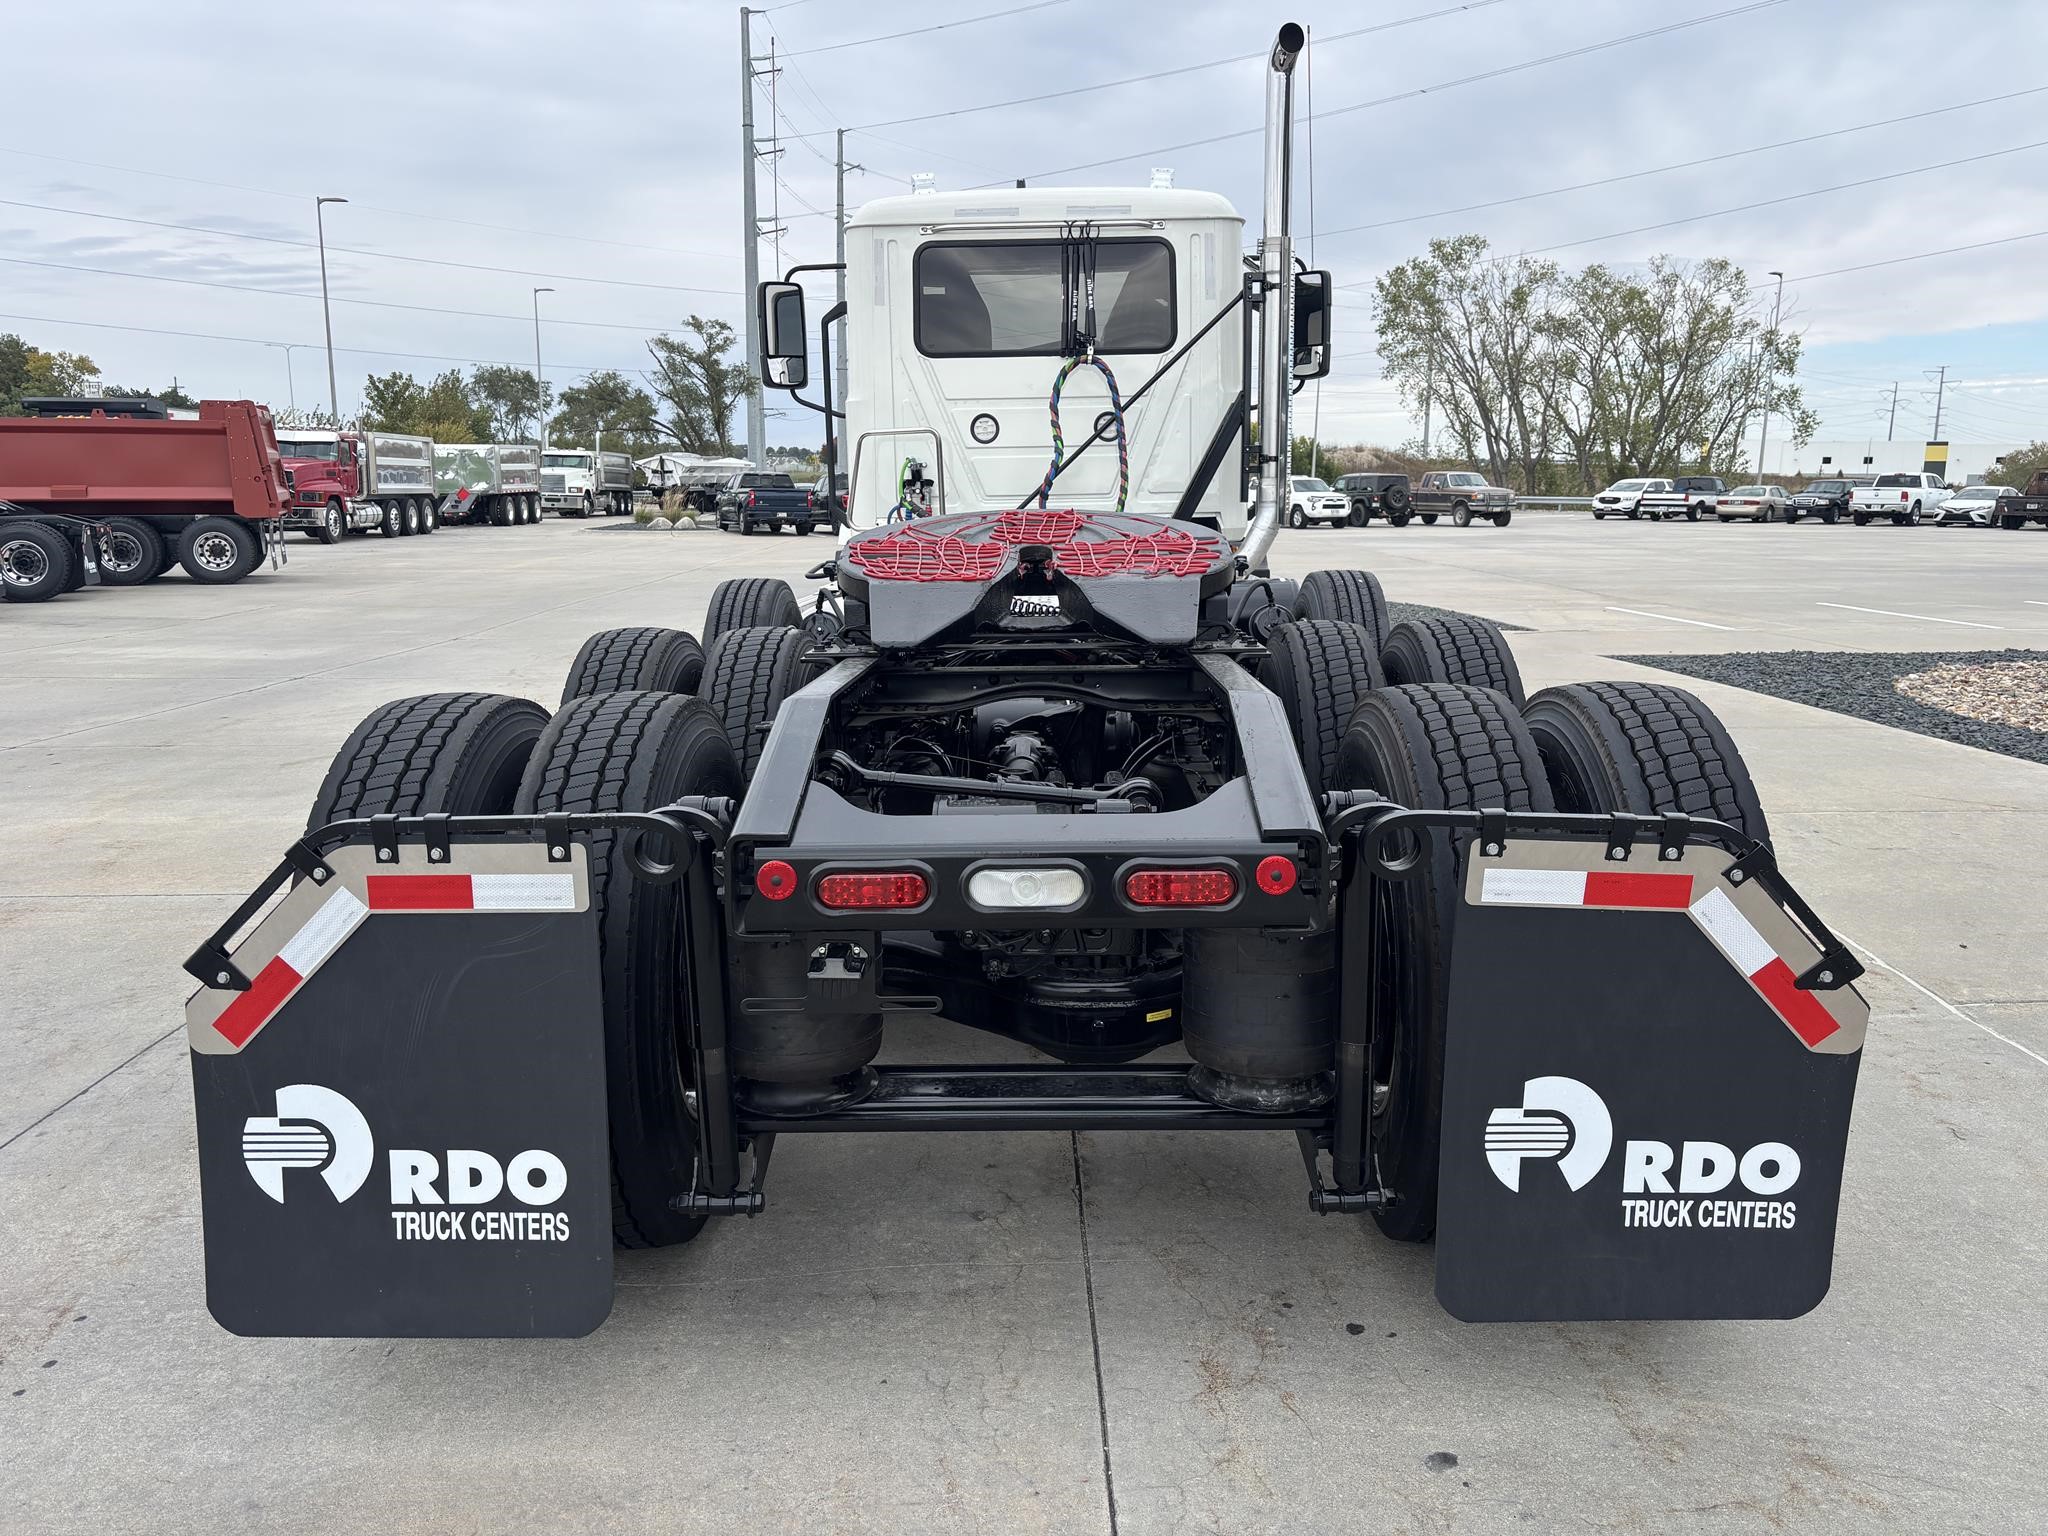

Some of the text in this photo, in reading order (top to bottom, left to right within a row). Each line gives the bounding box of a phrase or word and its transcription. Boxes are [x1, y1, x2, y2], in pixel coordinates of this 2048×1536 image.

[389, 1150, 568, 1206] RDO
[1623, 1141, 1801, 1196] RDO
[392, 1211, 570, 1242] TRUCK CENTERS
[1622, 1199, 1797, 1231] TRUCK CENTERS
